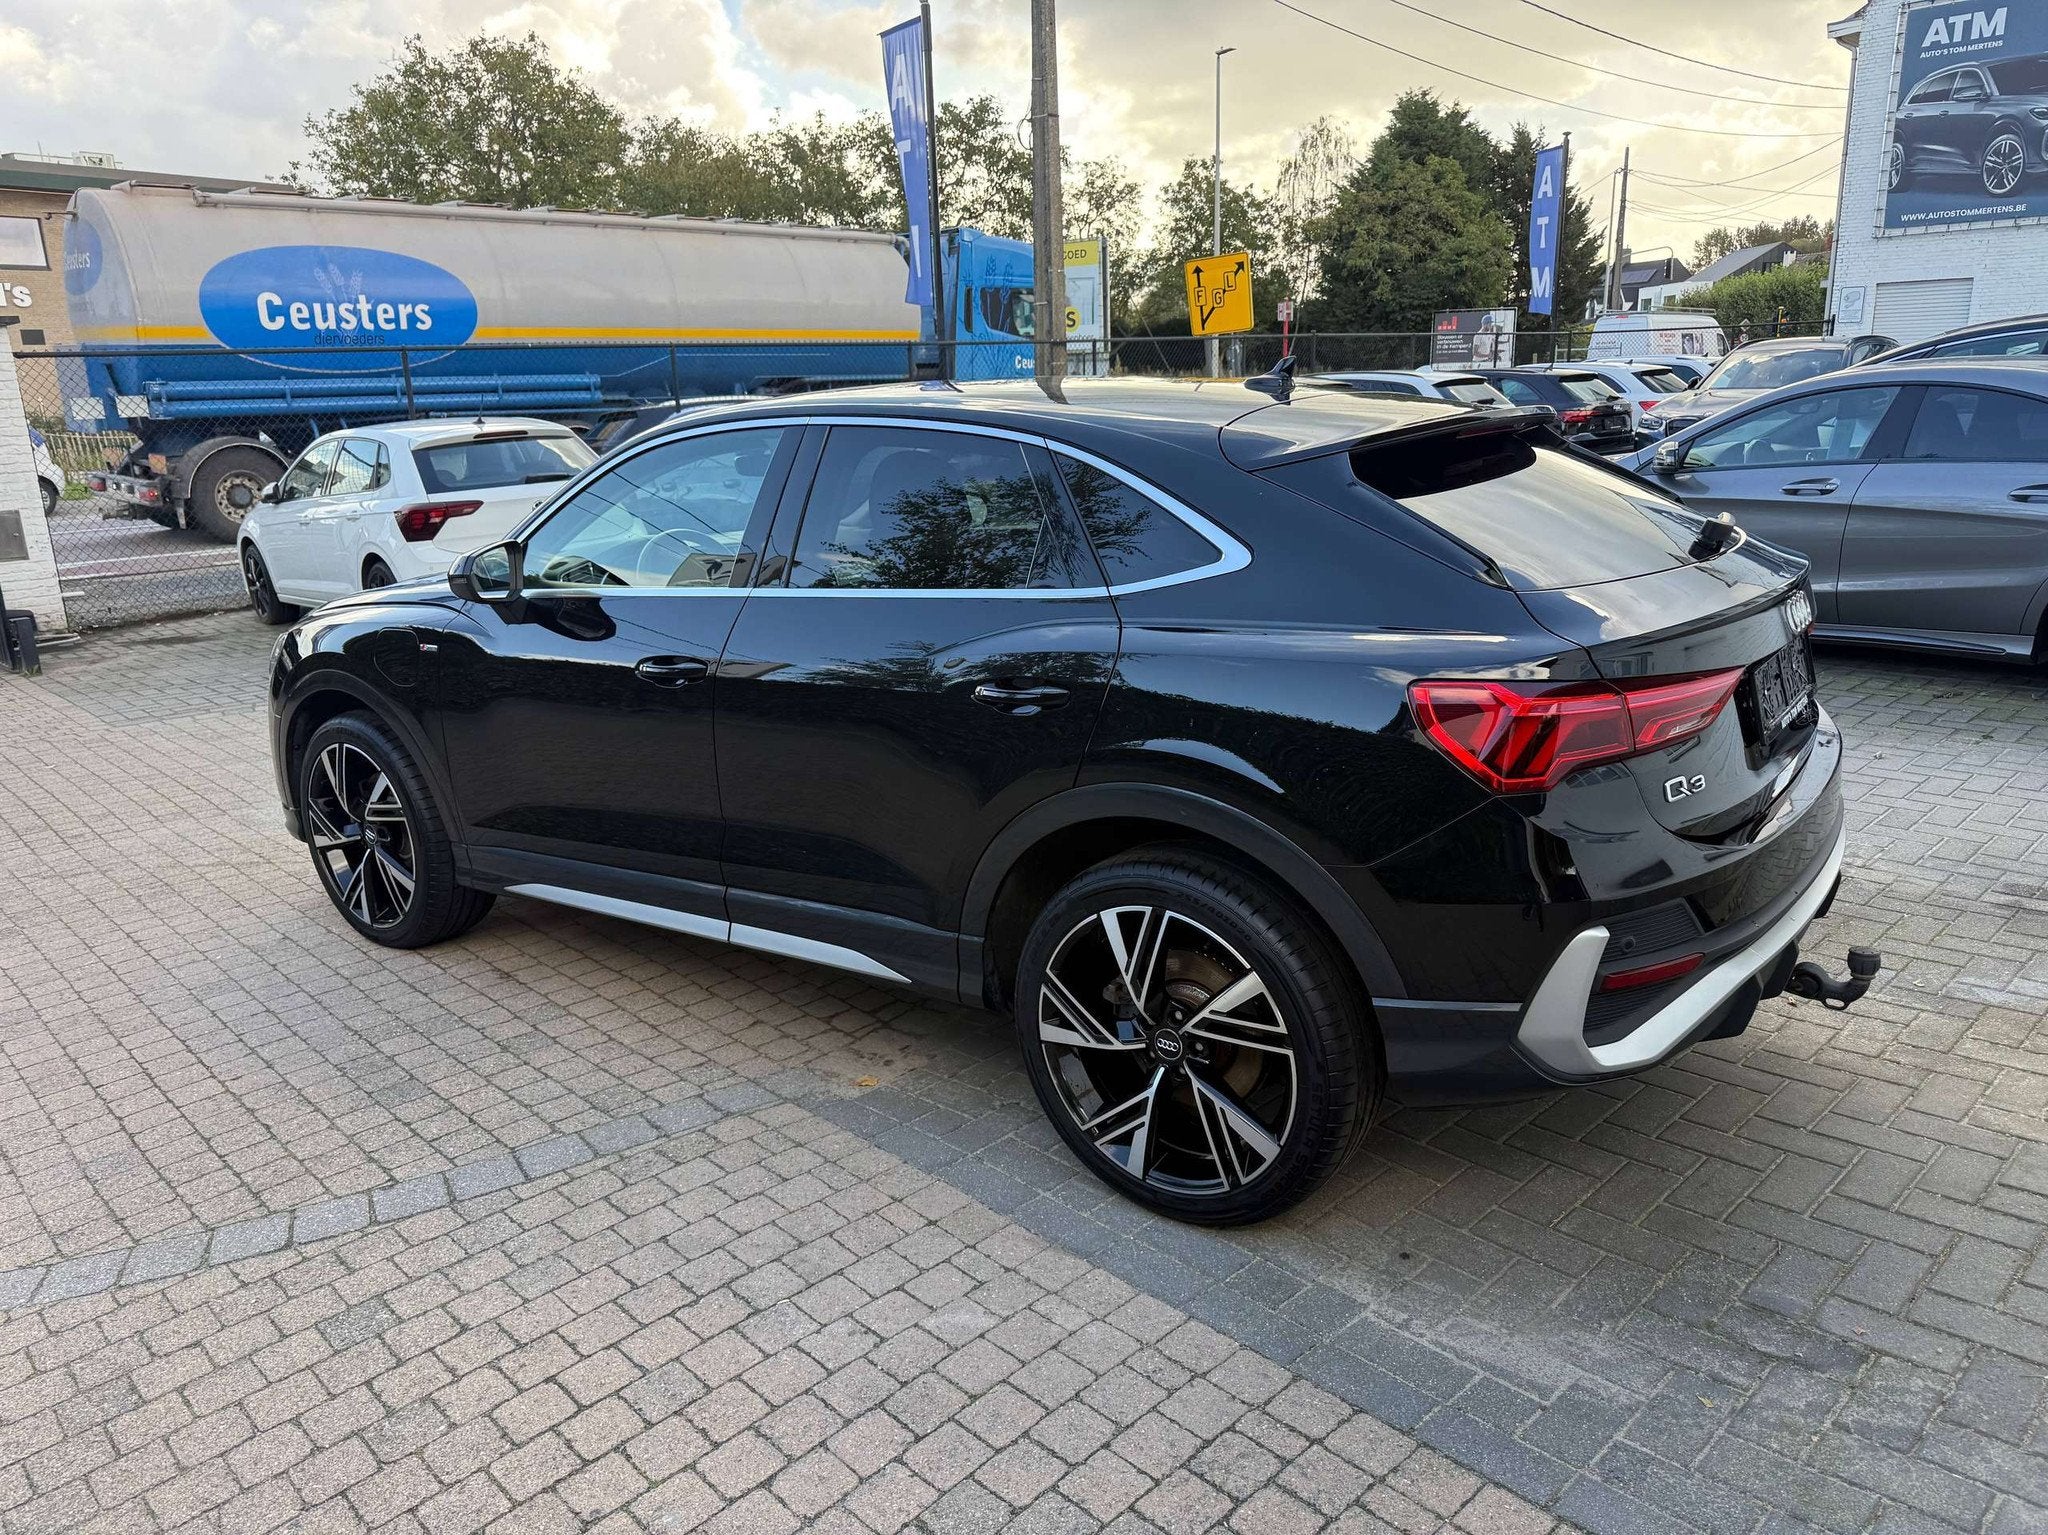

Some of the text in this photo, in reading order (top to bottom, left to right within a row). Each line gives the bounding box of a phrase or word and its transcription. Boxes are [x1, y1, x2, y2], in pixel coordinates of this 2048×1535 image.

[1921, 6, 2008, 48] ATM
[1920, 40, 2004, 59] AUTO'S TOM MERTENS
[1900, 203, 2027, 222] WWW.AUTOSTOMMERTENS.BE
[1226, 274, 1234, 288] L
[1197, 289, 1204, 304] F
[1214, 291, 1223, 305] G
[256, 291, 433, 332] Ceusters
[314, 332, 385, 345] diervoeders
[1015, 355, 1035, 369] Ceu
[1664, 774, 1706, 802] Q3
